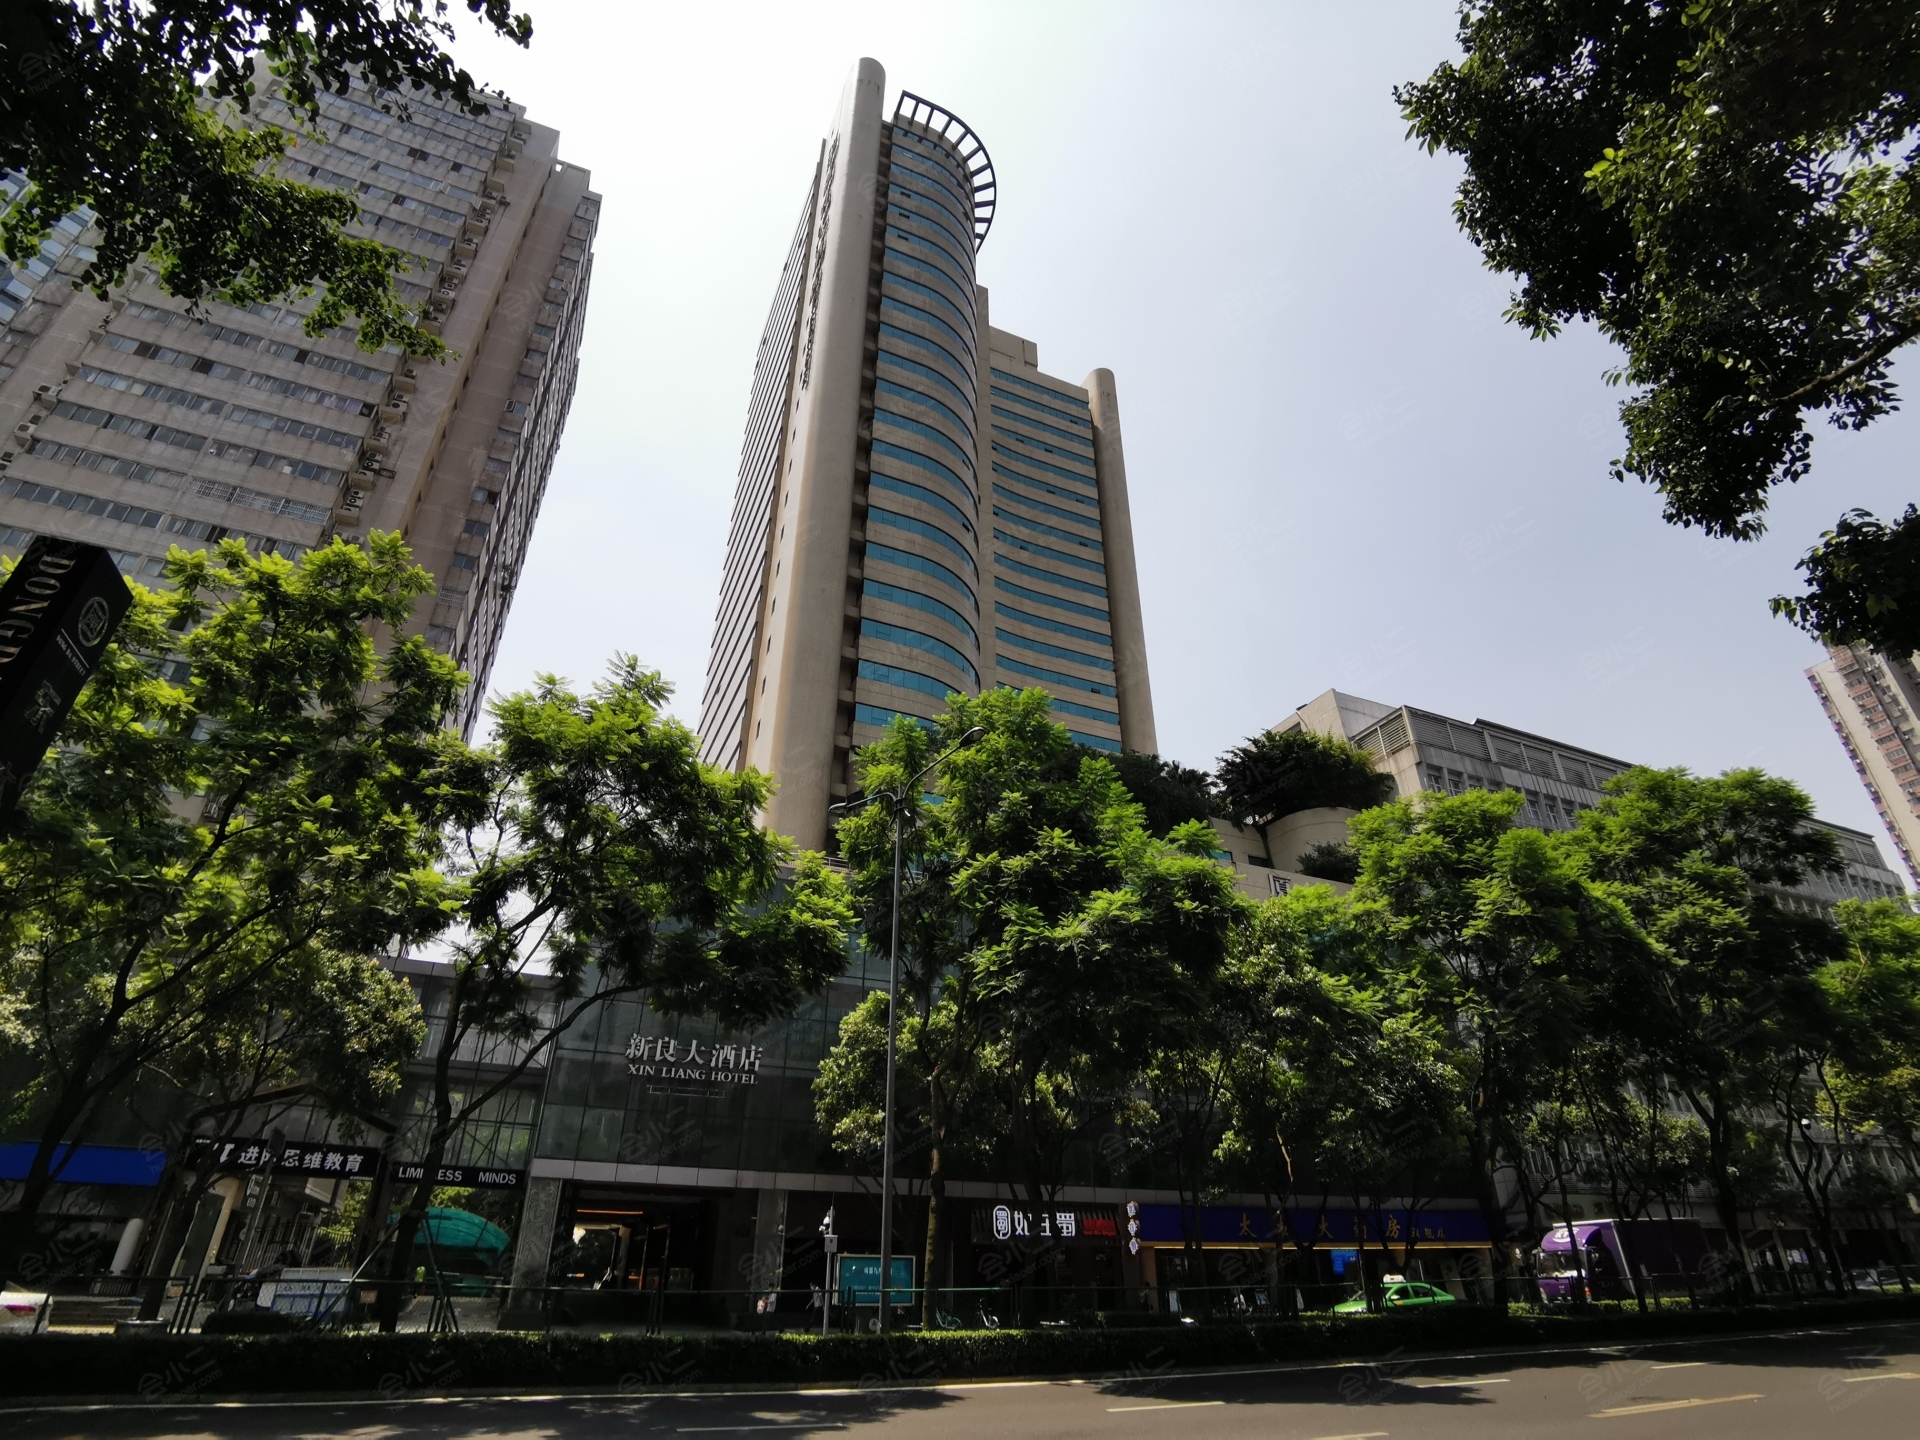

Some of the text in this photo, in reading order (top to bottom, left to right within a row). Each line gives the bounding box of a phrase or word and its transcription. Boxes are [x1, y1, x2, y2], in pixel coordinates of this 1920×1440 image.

[625, 1032, 764, 1072] 新良大酒店
[627, 1063, 759, 1085] XIN LIANG HOTEL
[398, 1166, 517, 1185] LIMIESS MINDS
